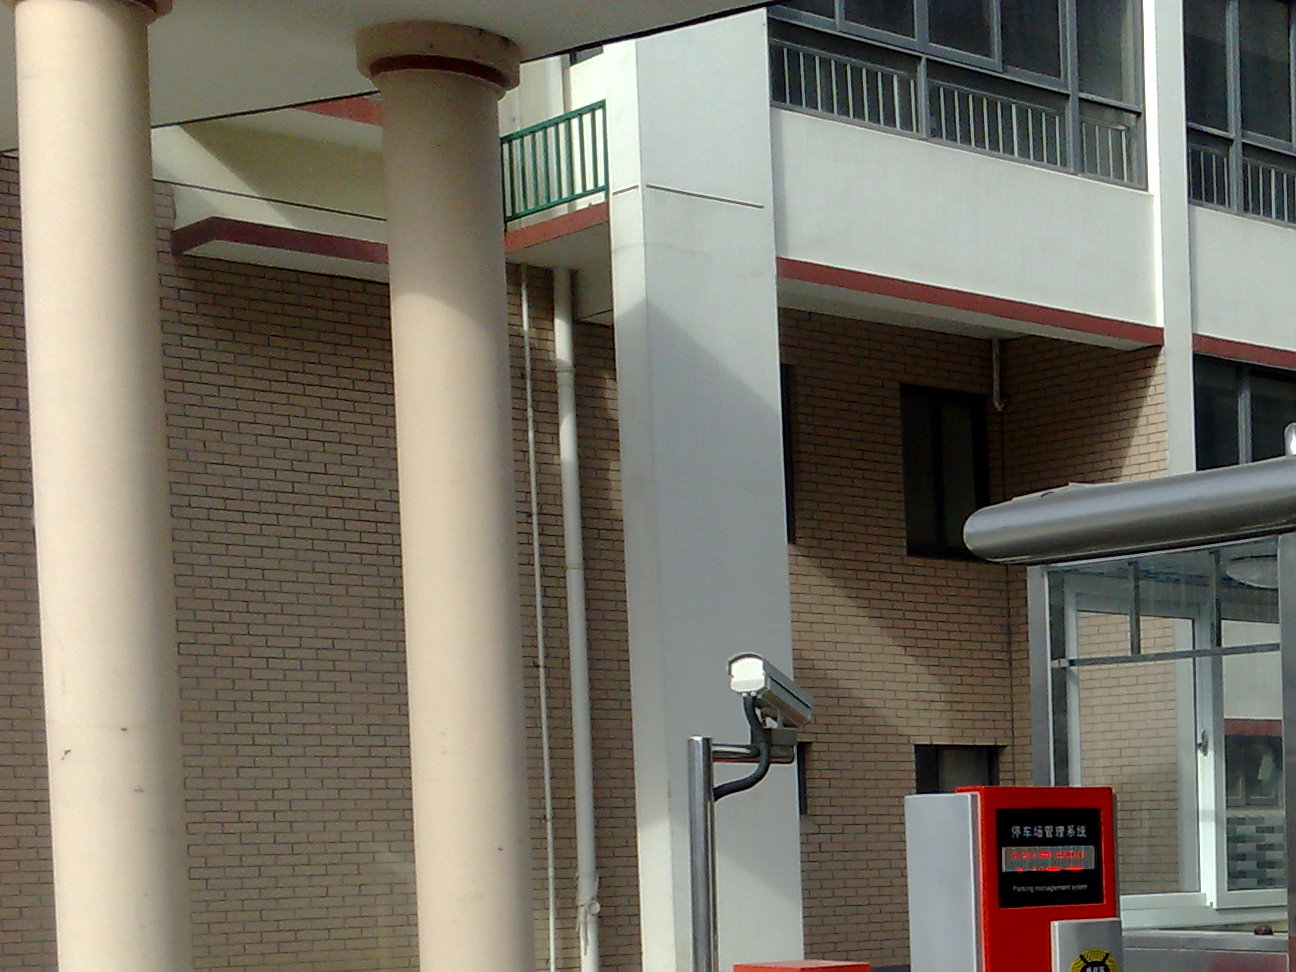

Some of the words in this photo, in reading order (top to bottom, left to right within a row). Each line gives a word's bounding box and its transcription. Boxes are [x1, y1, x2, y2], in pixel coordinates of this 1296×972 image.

[1011, 825, 1087, 839] 停车场管理系统
[1012, 885, 1034, 893] Parking
[1035, 884, 1071, 892] management
